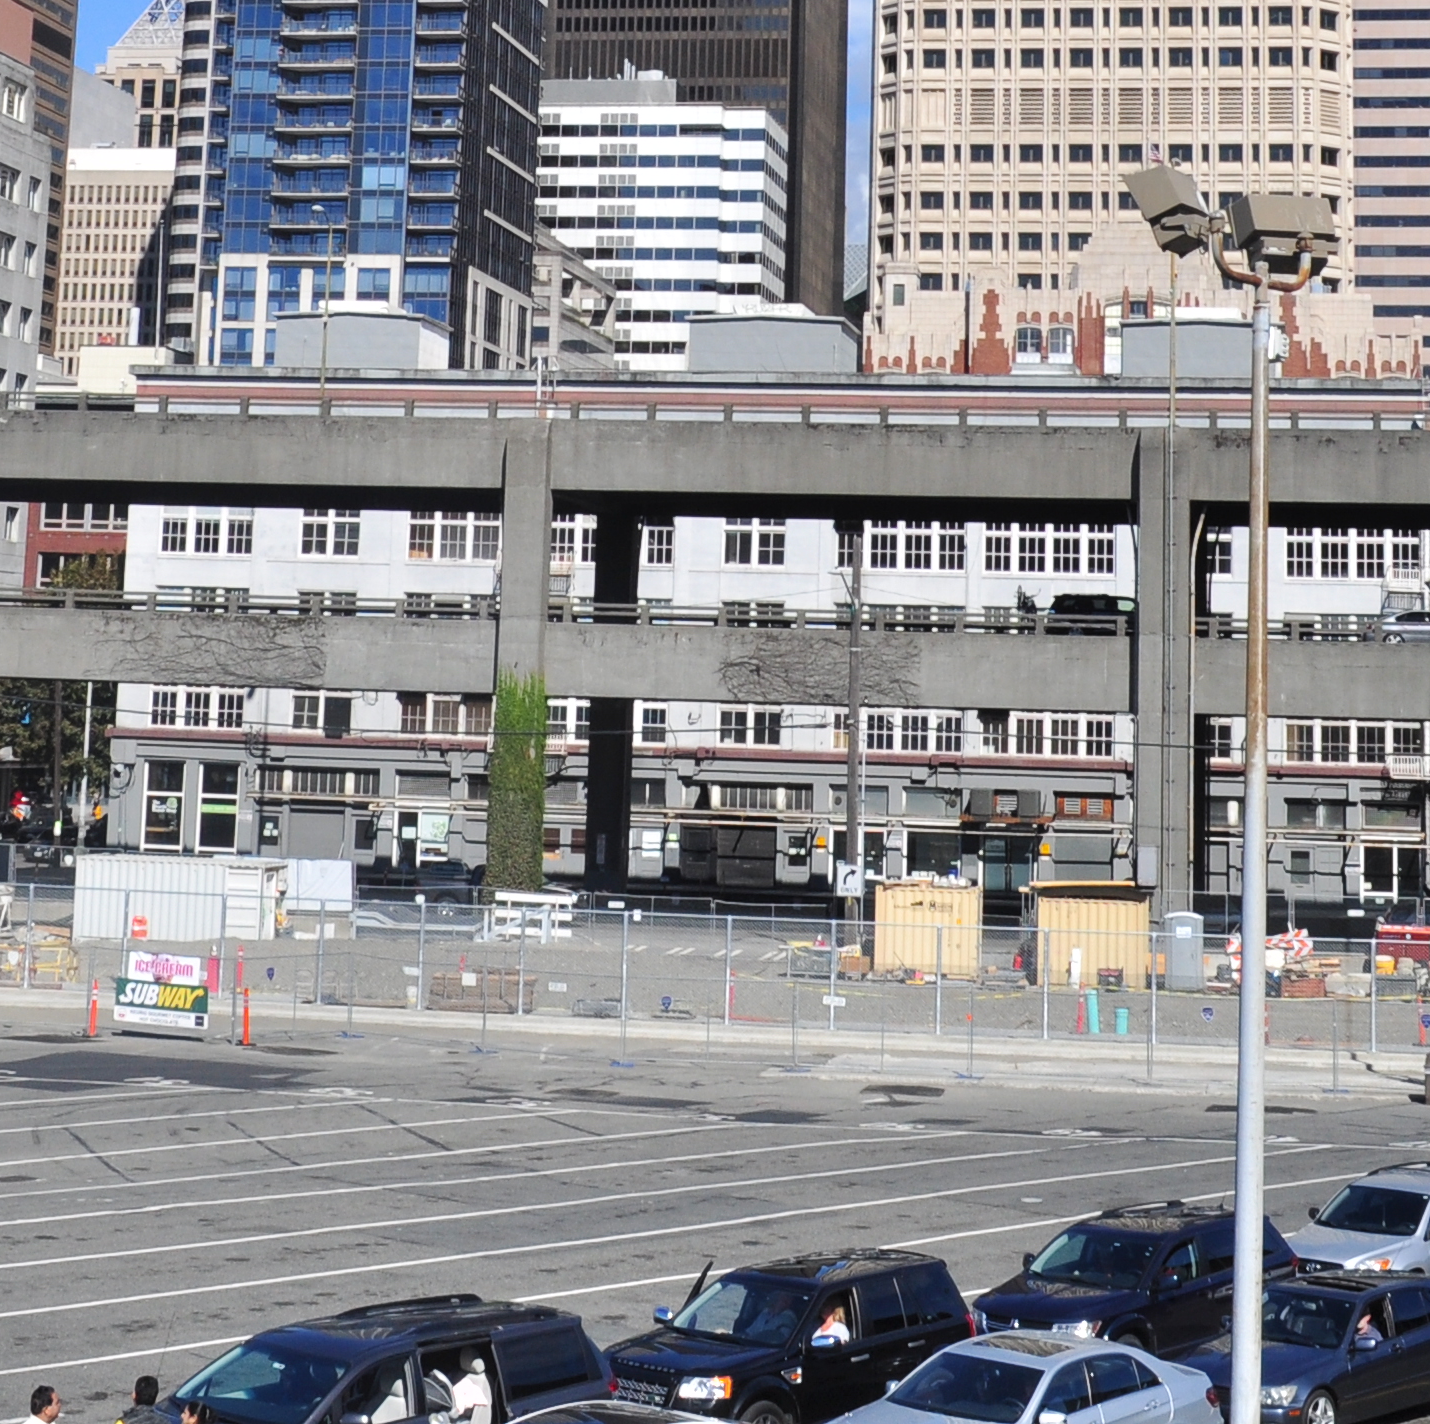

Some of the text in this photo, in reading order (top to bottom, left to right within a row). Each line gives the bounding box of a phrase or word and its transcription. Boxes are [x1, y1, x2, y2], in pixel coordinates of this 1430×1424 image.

[840, 886, 859, 894] ONLY
[134, 959, 194, 978] ICE CREAM
[118, 981, 205, 1010] SUBWAY
